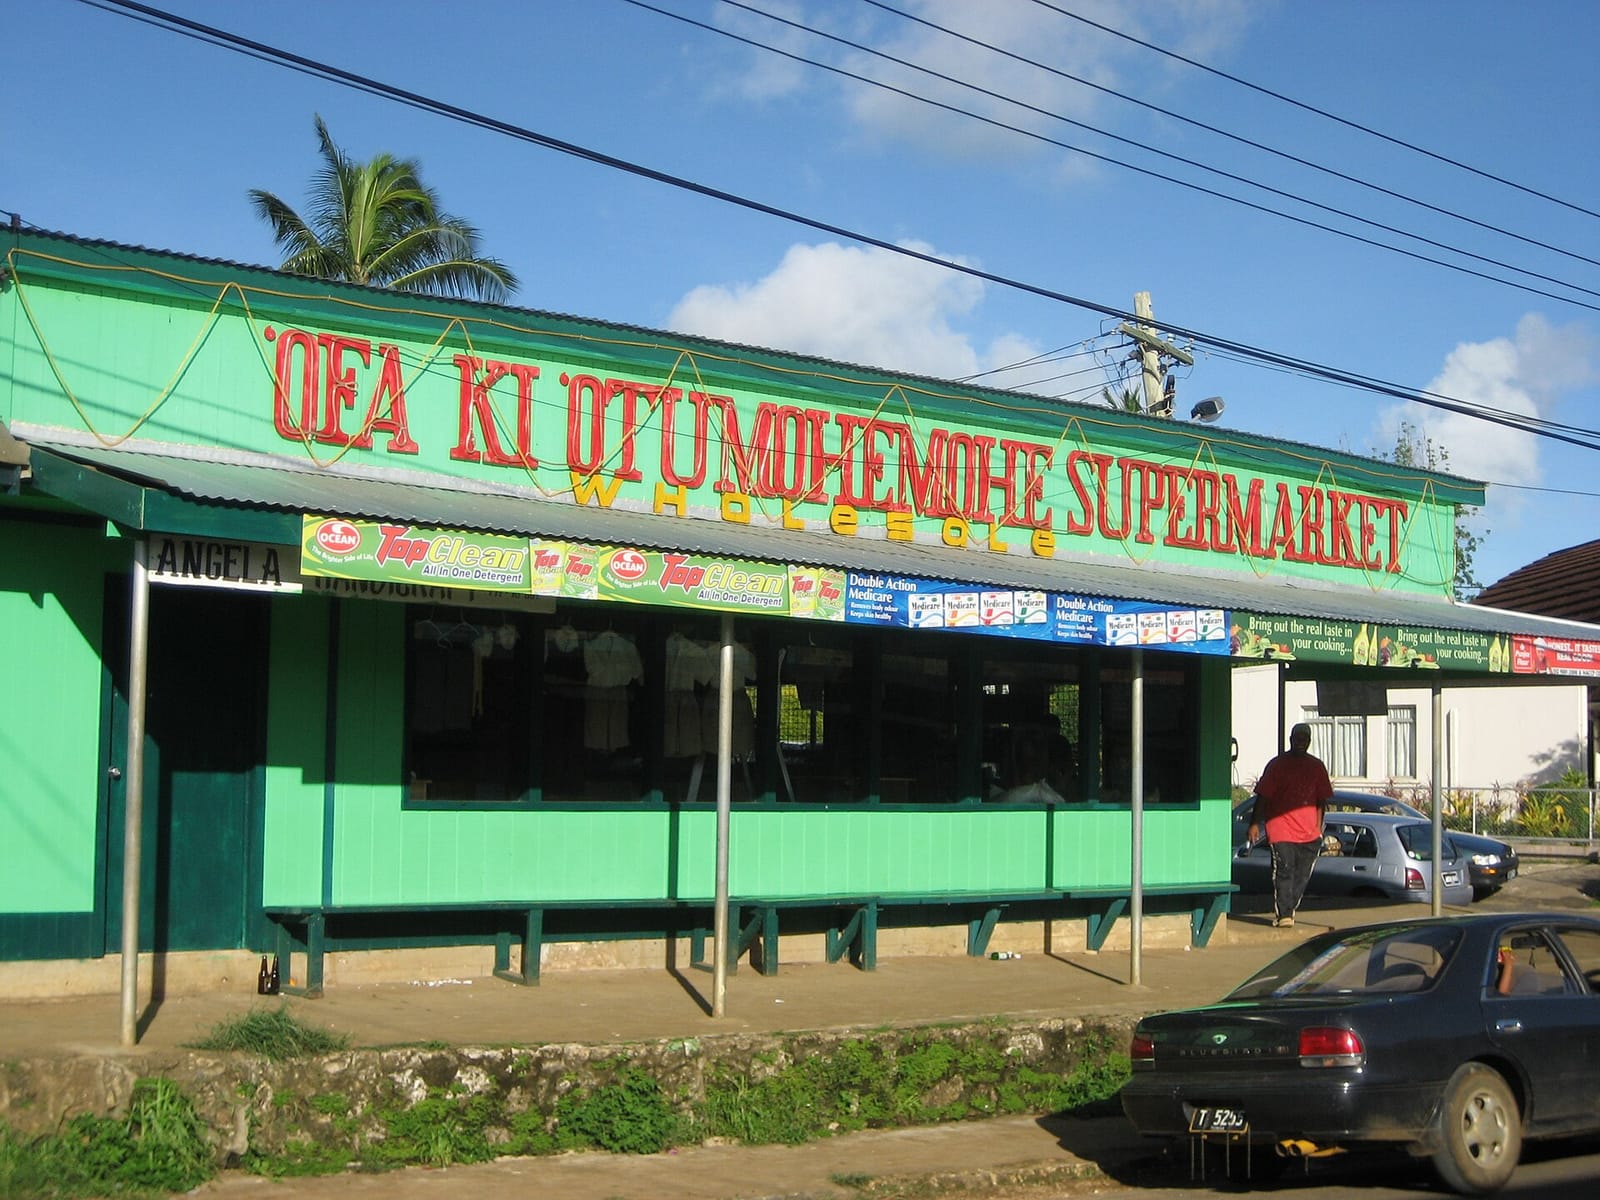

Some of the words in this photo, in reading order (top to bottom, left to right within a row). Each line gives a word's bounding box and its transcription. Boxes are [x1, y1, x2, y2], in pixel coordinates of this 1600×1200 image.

[450, 353, 540, 470] KI
[1068, 449, 1410, 573] SUPERMARKET
[320, 533, 357, 546] OCEAN
[155, 538, 282, 583] ANGELA
[311, 545, 322, 557] The
[356, 553, 363, 561] of
[363, 552, 374, 561] Life
[613, 561, 643, 572] OCEAN
[423, 564, 438, 577] All
[438, 565, 449, 578] In
[451, 567, 471, 579] One
[474, 569, 522, 585] Detergent
[849, 574, 885, 589] Double
[886, 578, 917, 592] Action
[698, 590, 711, 601] All
[711, 591, 721, 602] In
[722, 593, 738, 604] One
[741, 595, 782, 608] Detergent
[848, 587, 893, 603] Medicare
[911, 600, 941, 611] Medicare
[947, 599, 976, 610] Medicare
[983, 599, 1011, 609] Medicare
[1016, 598, 1044, 608] Medicare
[1056, 597, 1086, 610] Double
[1087, 600, 1114, 613] Action
[1055, 609, 1094, 624] Medicare
[1169, 618, 1193, 627] Medicare
[1199, 617, 1223, 626] Medicare
[1108, 622, 1135, 630] Medicare
[1140, 620, 1164, 629] Medicare
[1249, 616, 1272, 635] Bring
[1274, 620, 1289, 634] out
[1290, 619, 1304, 635] the
[1306, 621, 1323, 636] real
[1324, 624, 1343, 638] taste
[1344, 624, 1353, 638] in
[1397, 629, 1419, 647] Bring
[1419, 634, 1433, 645] out
[1434, 632, 1446, 646] the
[1447, 633, 1461, 646] real
[1462, 635, 1479, 647] taste
[1480, 635, 1488, 647] in
[1292, 638, 1312, 652] your
[1313, 638, 1353, 656] cooking...
[1435, 647, 1452, 661] your
[1198, 1109, 1208, 1127] T
